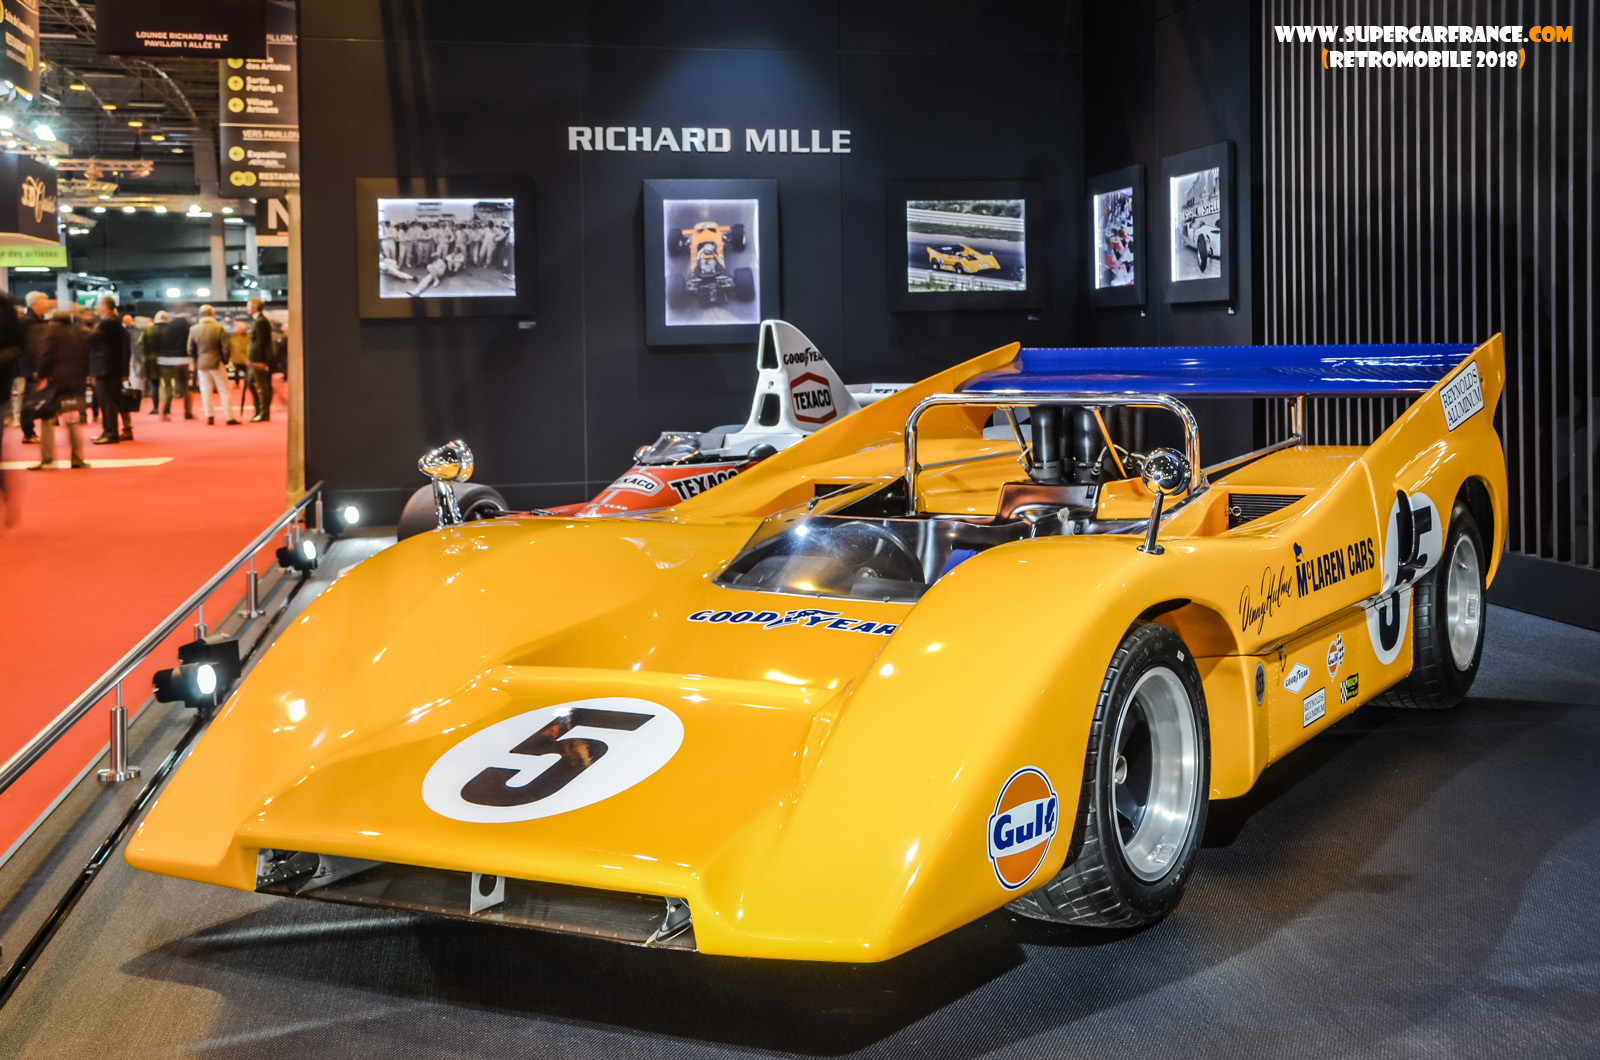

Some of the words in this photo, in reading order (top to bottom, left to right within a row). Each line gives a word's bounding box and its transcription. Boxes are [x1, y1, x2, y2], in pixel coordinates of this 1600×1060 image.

[136, 31, 168, 39] LOUNGE
[169, 32, 204, 40] RICHARD
[205, 33, 229, 41] MILLE
[144, 39, 182, 48] PAVILLON
[183, 40, 187, 48] 1
[188, 41, 213, 49] ALLÉE
[246, 84, 276, 94] Parking
[246, 98, 273, 107] Village
[242, 129, 263, 138] VERS
[568, 126, 731, 153] RICHARD
[745, 128, 851, 154] MILLE
[247, 150, 287, 159] Exposition
[1202, 201, 1219, 215] SHELL
[1441, 368, 1478, 409] REYNOLDS
[793, 388, 832, 411] TEXACO
[1347, 536, 1375, 576] CARS
[460, 706, 656, 807] 5
[993, 797, 1056, 850] Gulf
